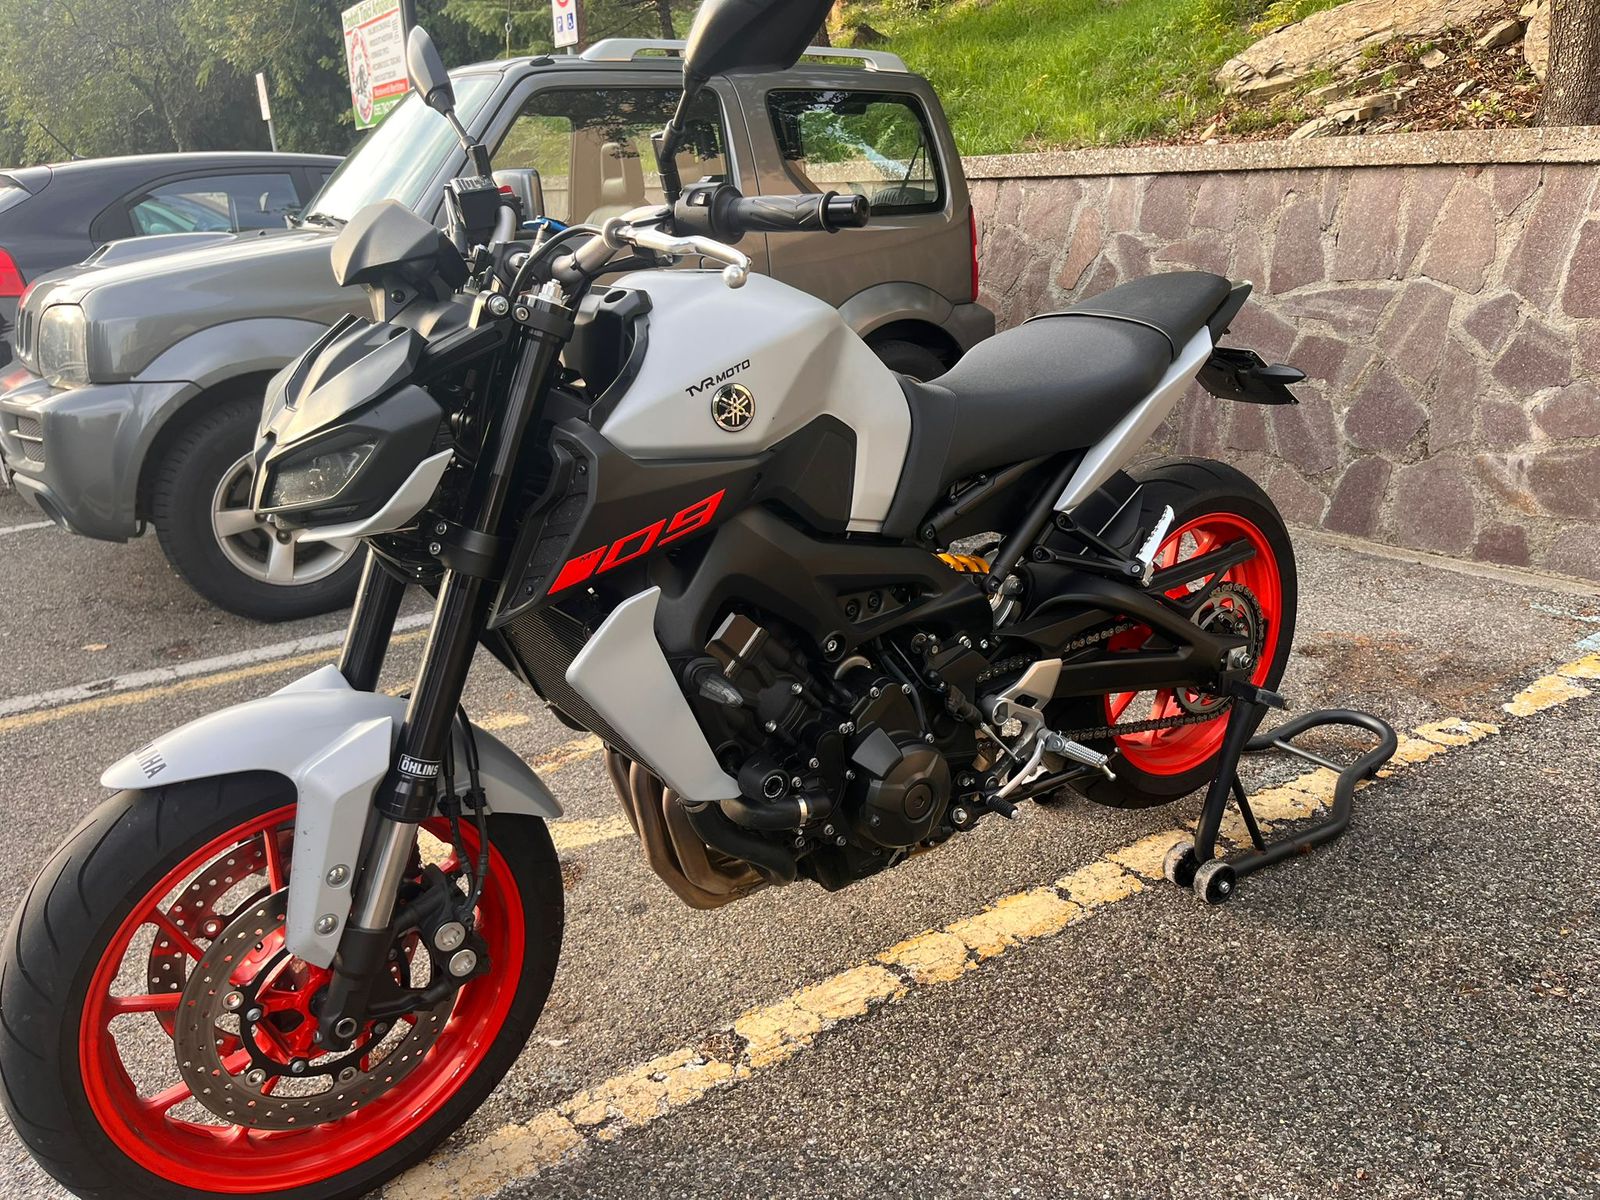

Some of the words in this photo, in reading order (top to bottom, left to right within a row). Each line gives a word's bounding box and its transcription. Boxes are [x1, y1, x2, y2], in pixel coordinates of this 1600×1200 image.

[685, 376, 716, 397] TVR
[716, 359, 751, 384] MOTO
[595, 488, 727, 575] 09
[400, 756, 439, 776] ÖHLINS
